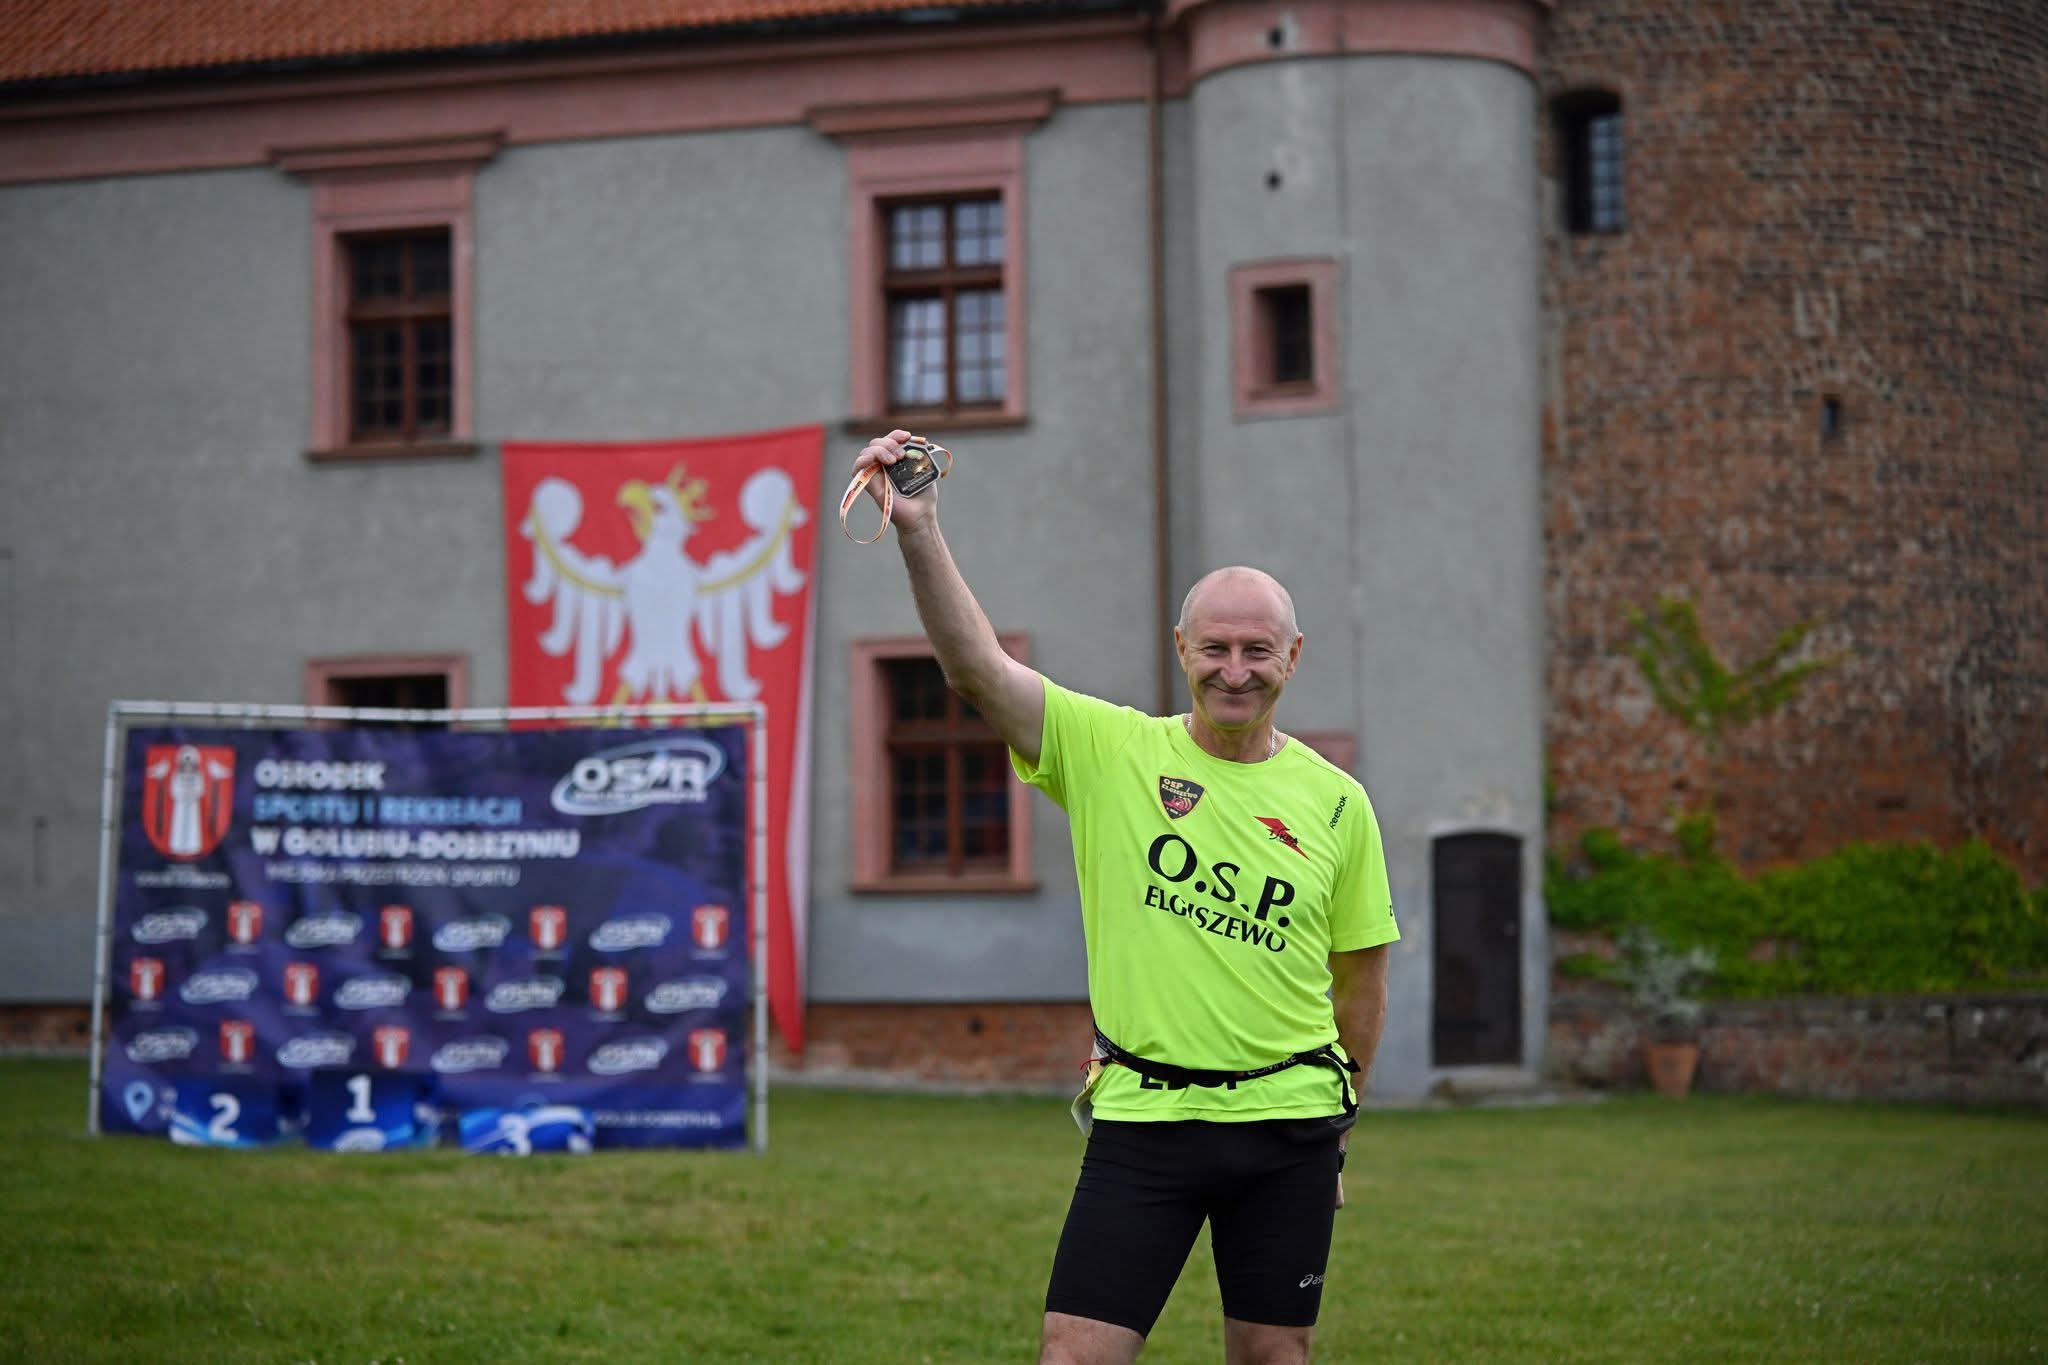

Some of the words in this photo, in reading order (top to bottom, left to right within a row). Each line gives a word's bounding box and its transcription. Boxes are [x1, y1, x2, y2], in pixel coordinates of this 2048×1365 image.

[1329, 795, 1347, 829] Reebok
[250, 826, 280, 855] W
[1144, 885, 1286, 952] ELGISZEWO
[209, 1093, 240, 1142] 2
[345, 1074, 376, 1123] 1
